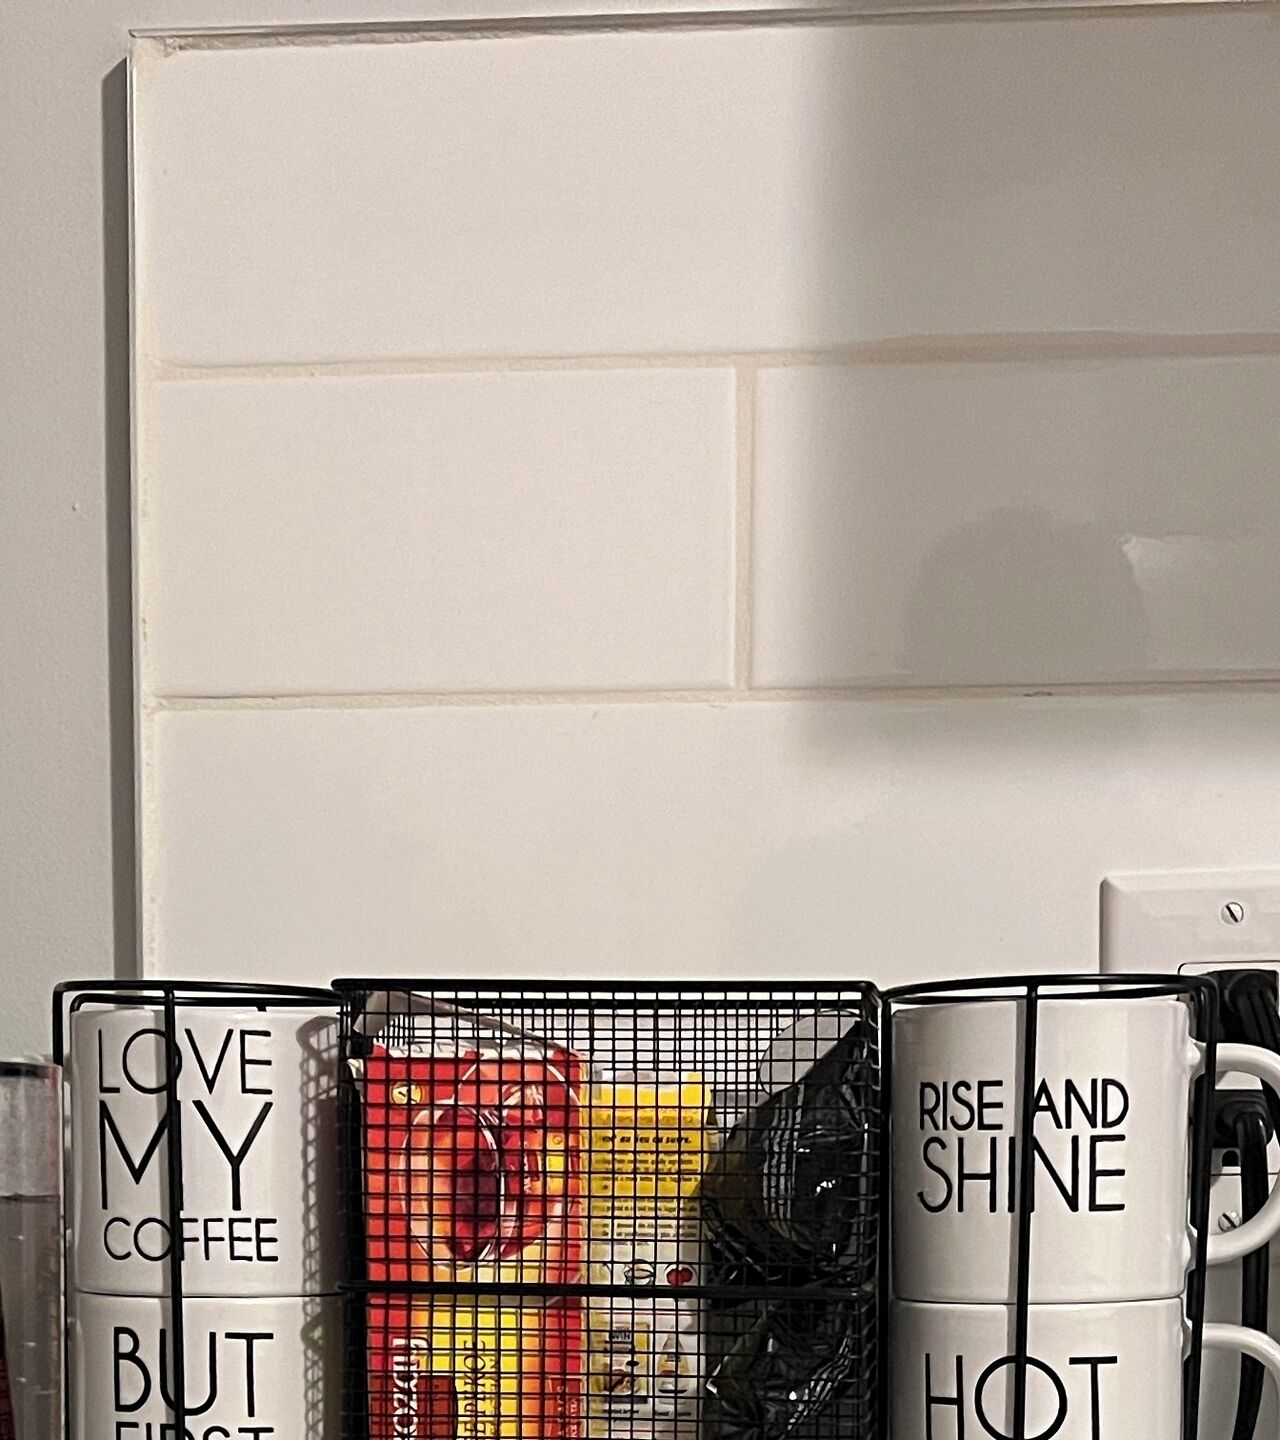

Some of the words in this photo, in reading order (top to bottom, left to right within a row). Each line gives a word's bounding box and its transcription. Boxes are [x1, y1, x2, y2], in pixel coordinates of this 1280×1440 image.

[98, 1028, 273, 1094] LOVE
[919, 1079, 1004, 1131] RISE
[1033, 1077, 1130, 1130] AND
[99, 1099, 273, 1211] MY
[917, 1134, 1126, 1213] SHINE
[103, 1216, 279, 1262] COFFEE
[113, 1326, 274, 1418] BUT
